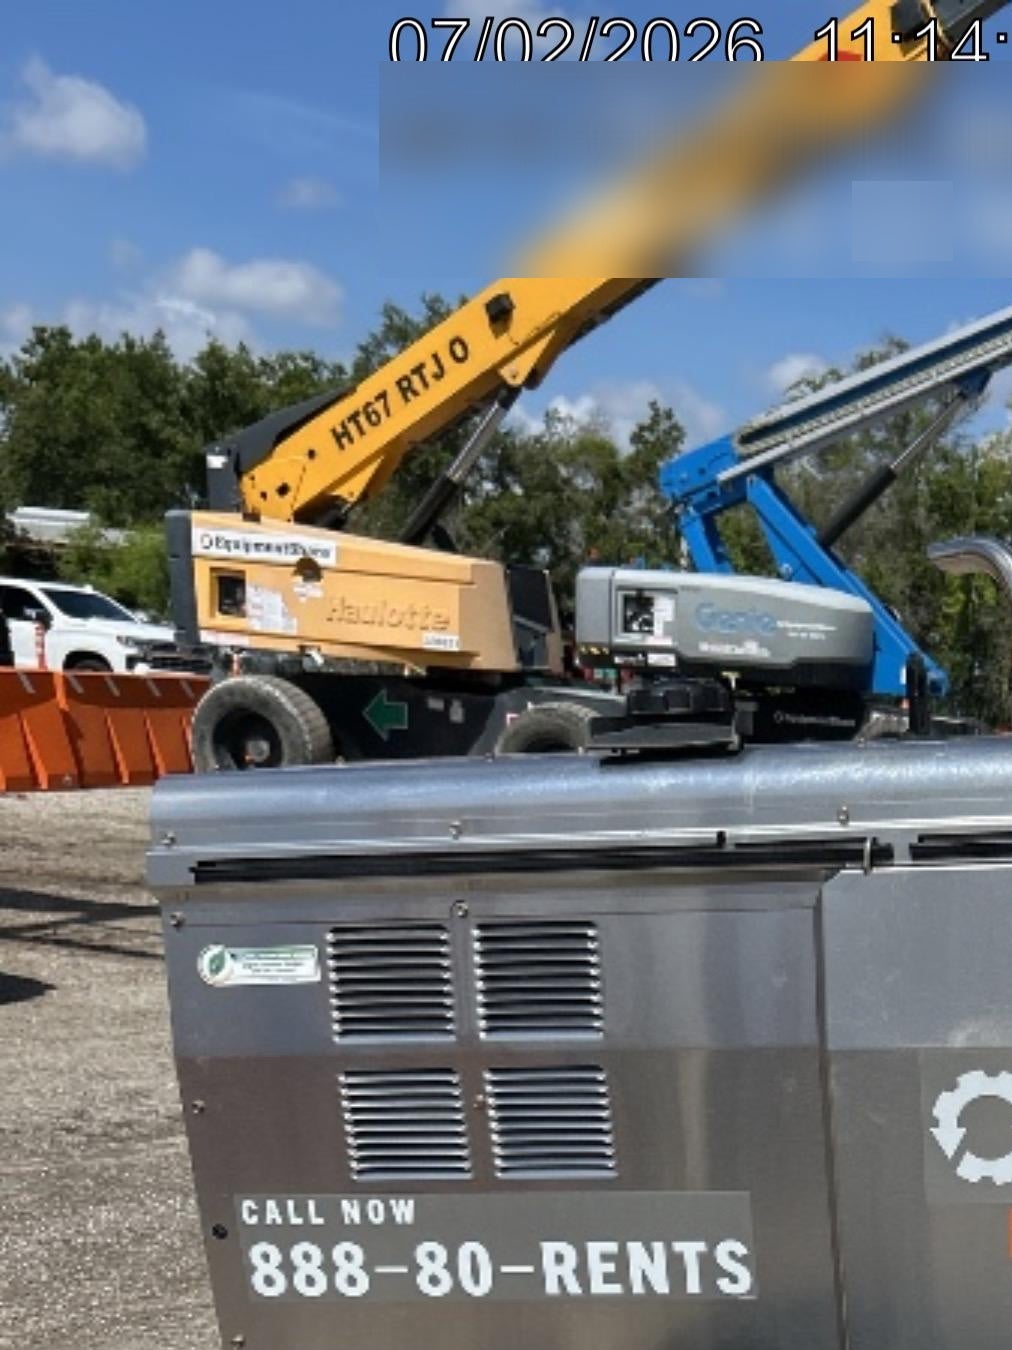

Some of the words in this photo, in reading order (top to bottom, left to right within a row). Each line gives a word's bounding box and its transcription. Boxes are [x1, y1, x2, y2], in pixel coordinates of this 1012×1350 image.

[330, 389, 391, 451] HT67
[395, 351, 445, 404] RTJ
[240, 1198, 325, 1226] CALL
[341, 1198, 417, 1225] NOW
[248, 1238, 755, 1298] 888-80-RENTS
